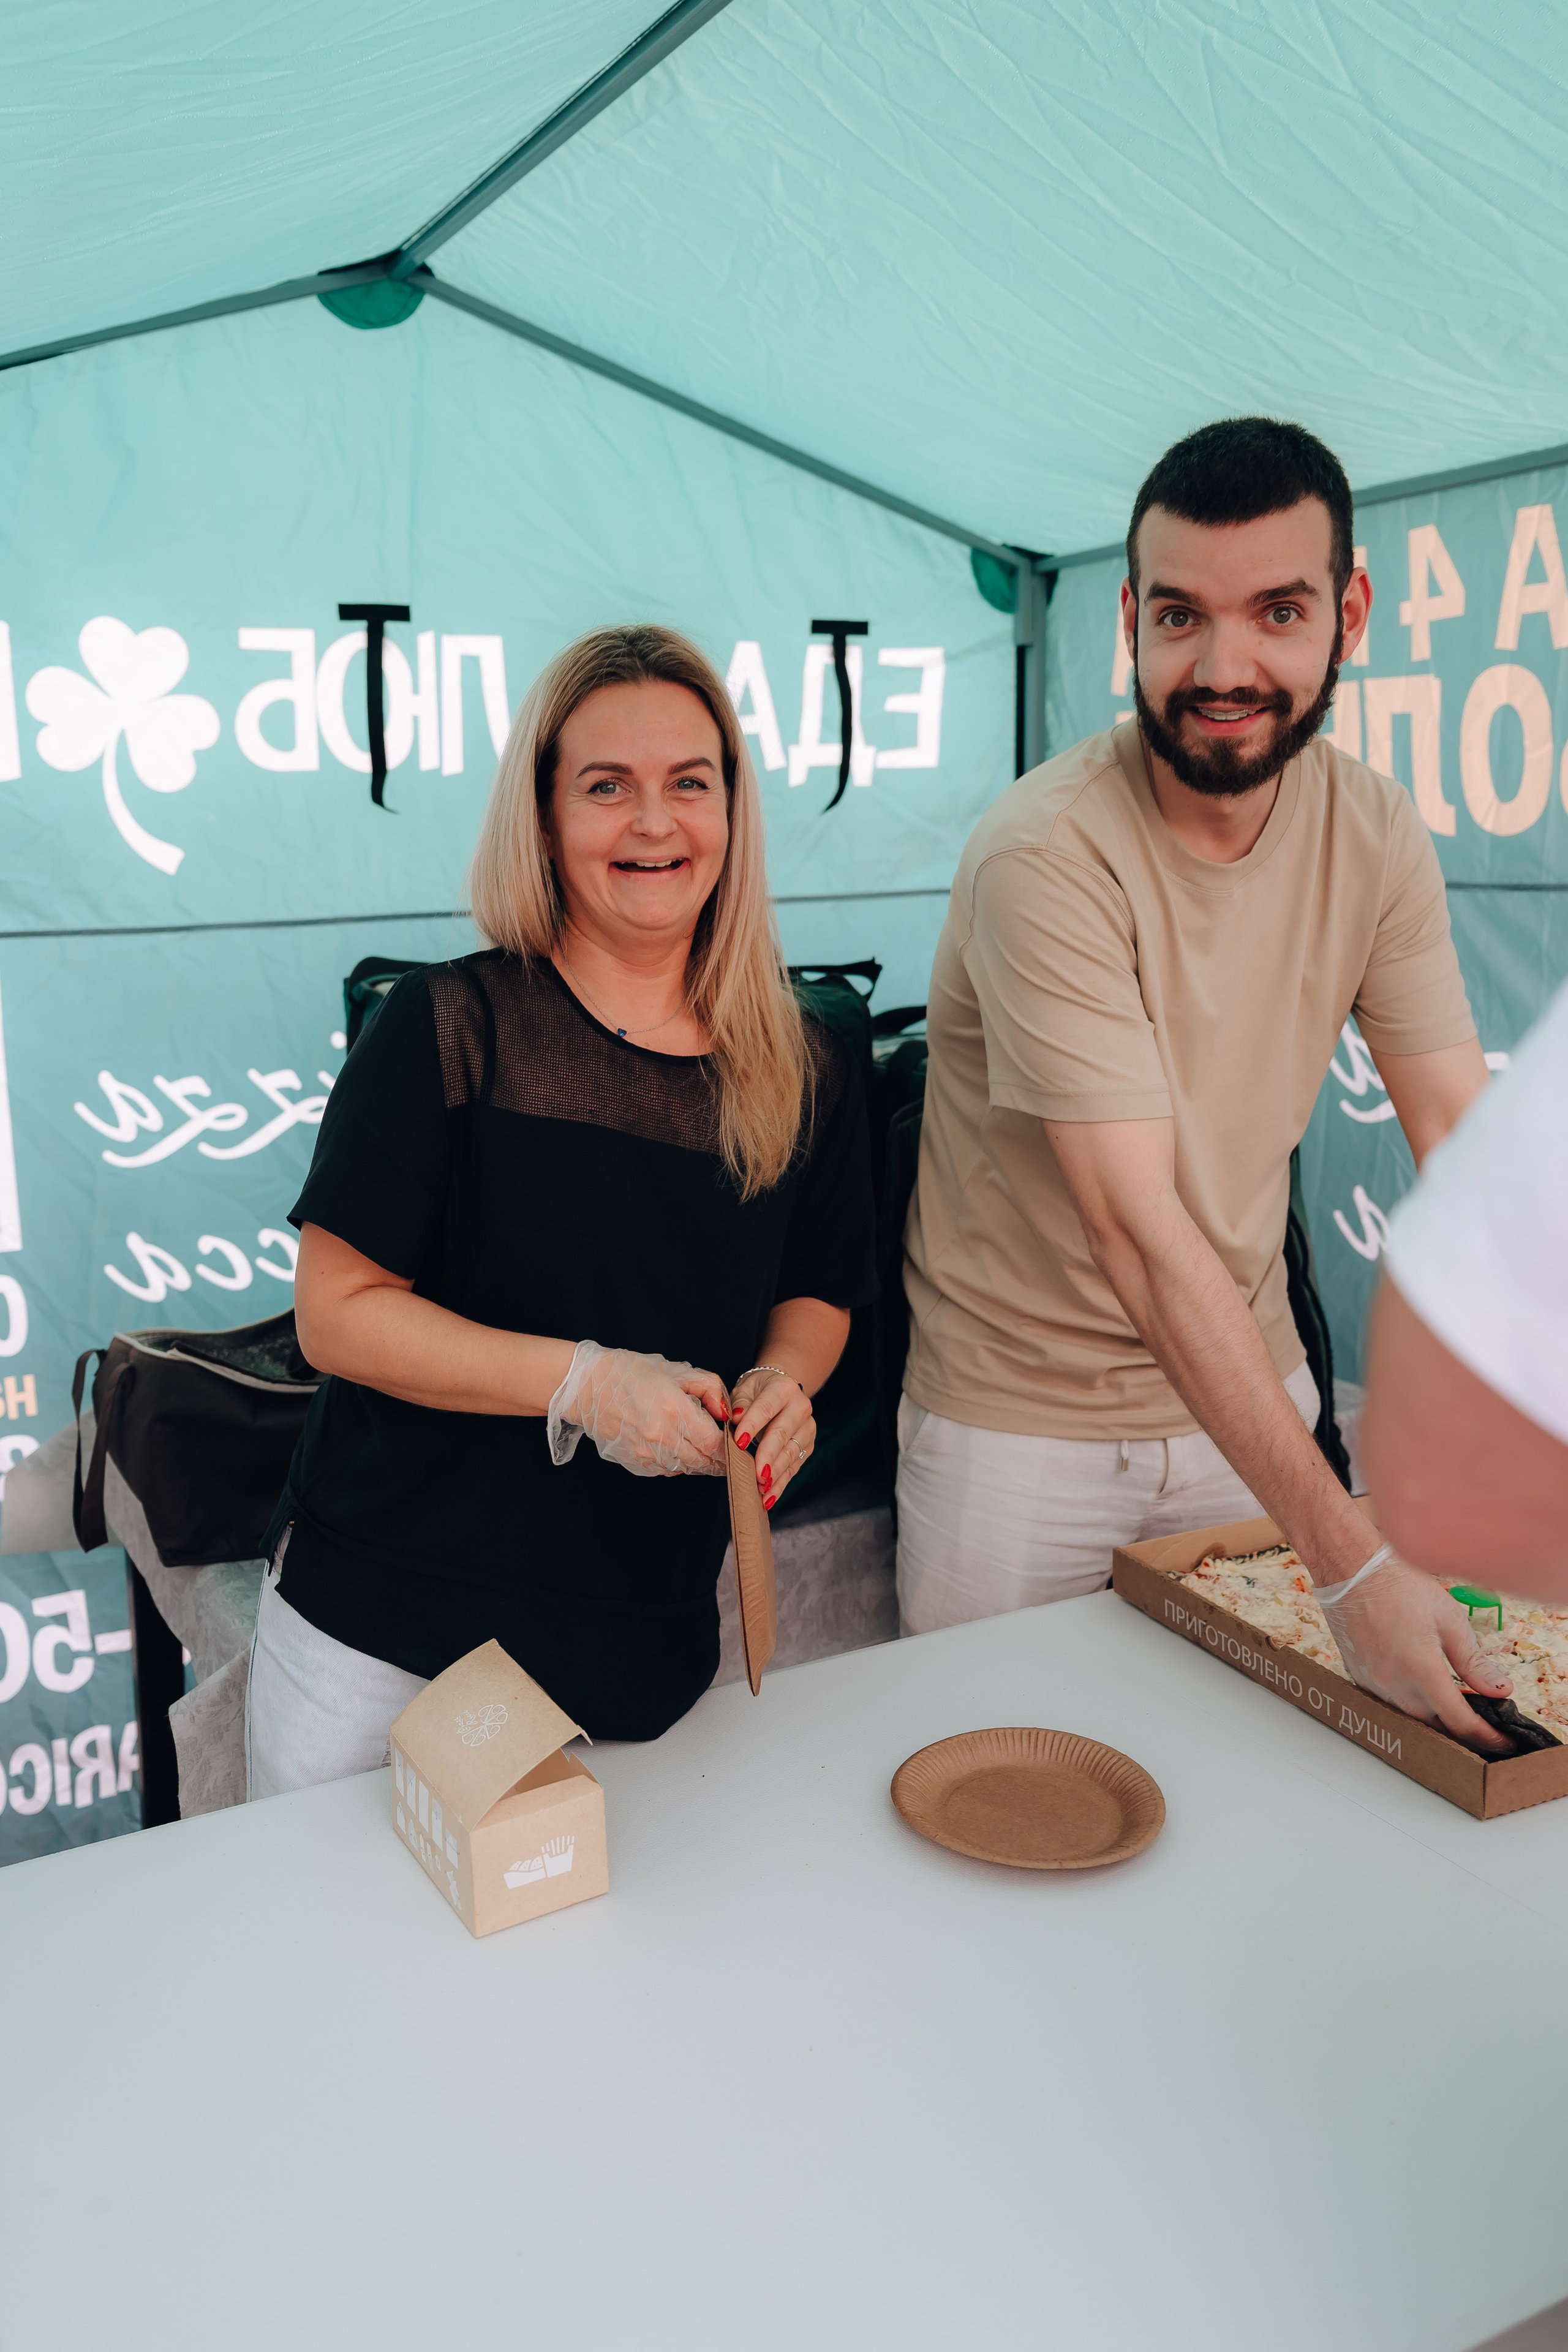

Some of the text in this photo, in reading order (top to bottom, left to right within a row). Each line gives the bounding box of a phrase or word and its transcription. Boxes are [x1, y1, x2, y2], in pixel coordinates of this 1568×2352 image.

[1164, 1597, 1402, 1760] ПРИГОТОВЛЕНО ОТ ДУШИ
